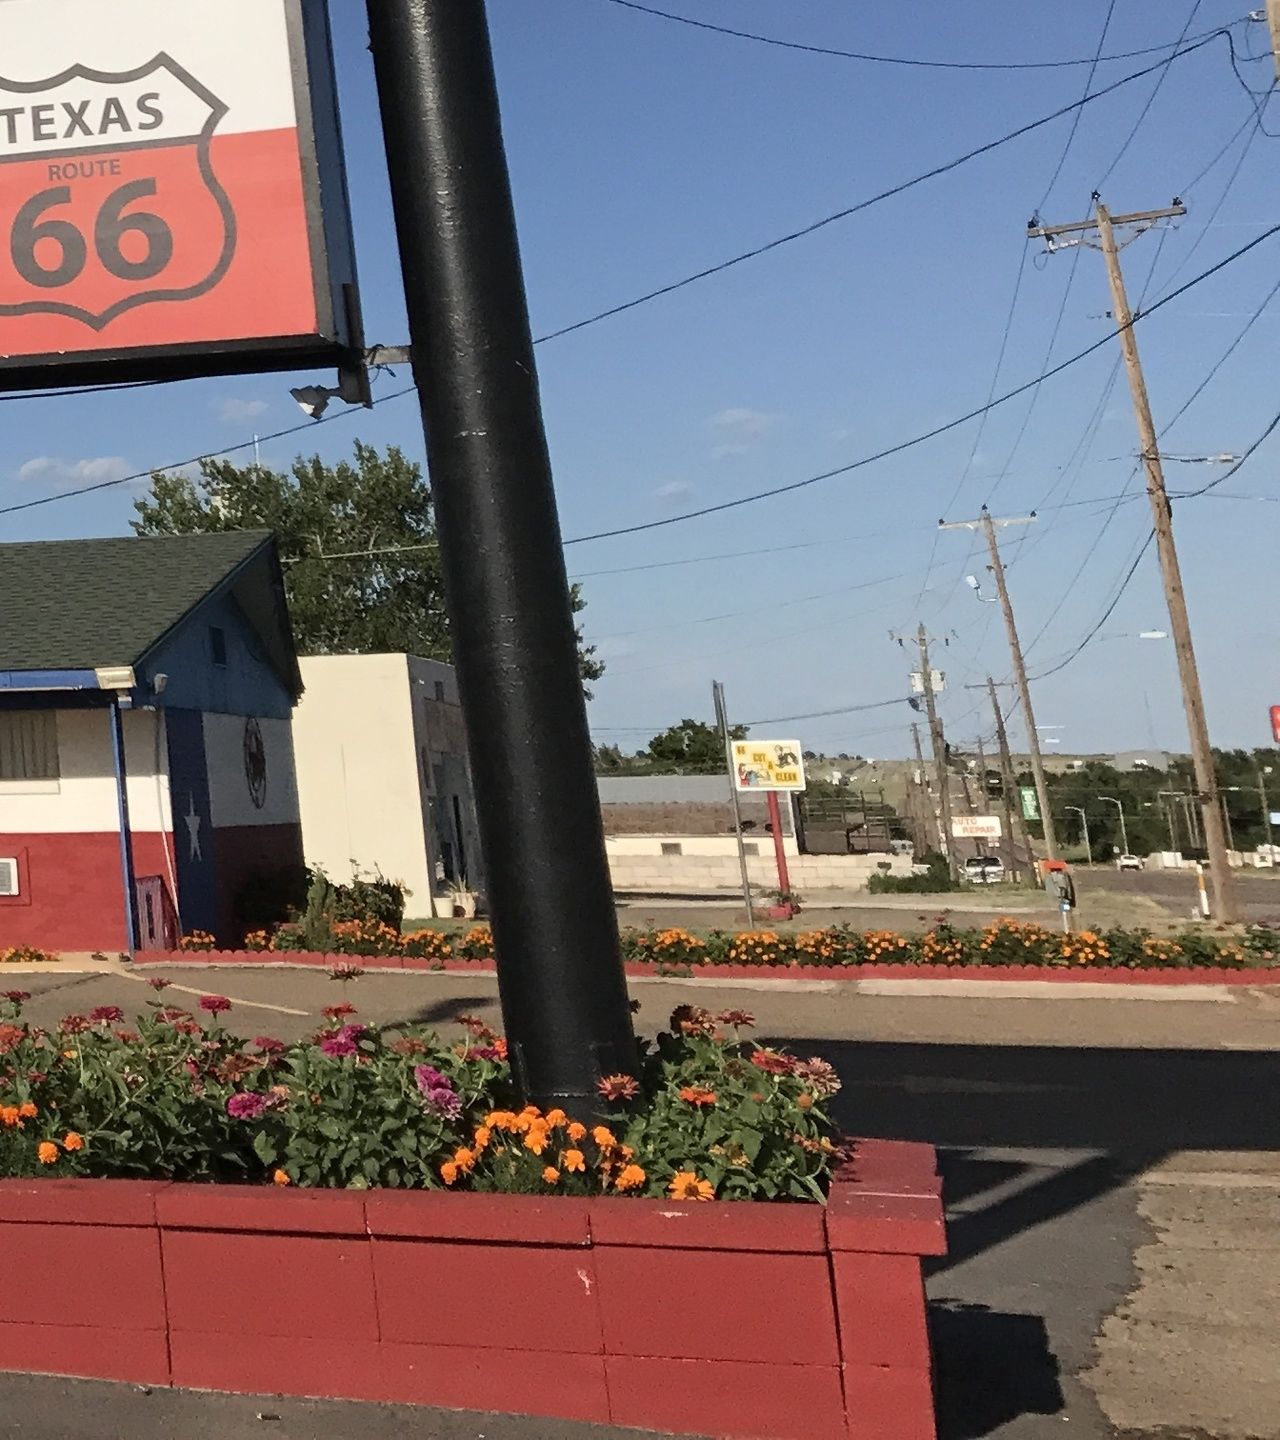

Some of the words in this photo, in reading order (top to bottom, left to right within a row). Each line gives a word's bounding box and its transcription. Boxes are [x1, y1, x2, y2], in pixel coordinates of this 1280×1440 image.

[47, 158, 122, 182] ROUTE
[8, 177, 174, 289] 66
[962, 826, 996, 834] REPAIR
